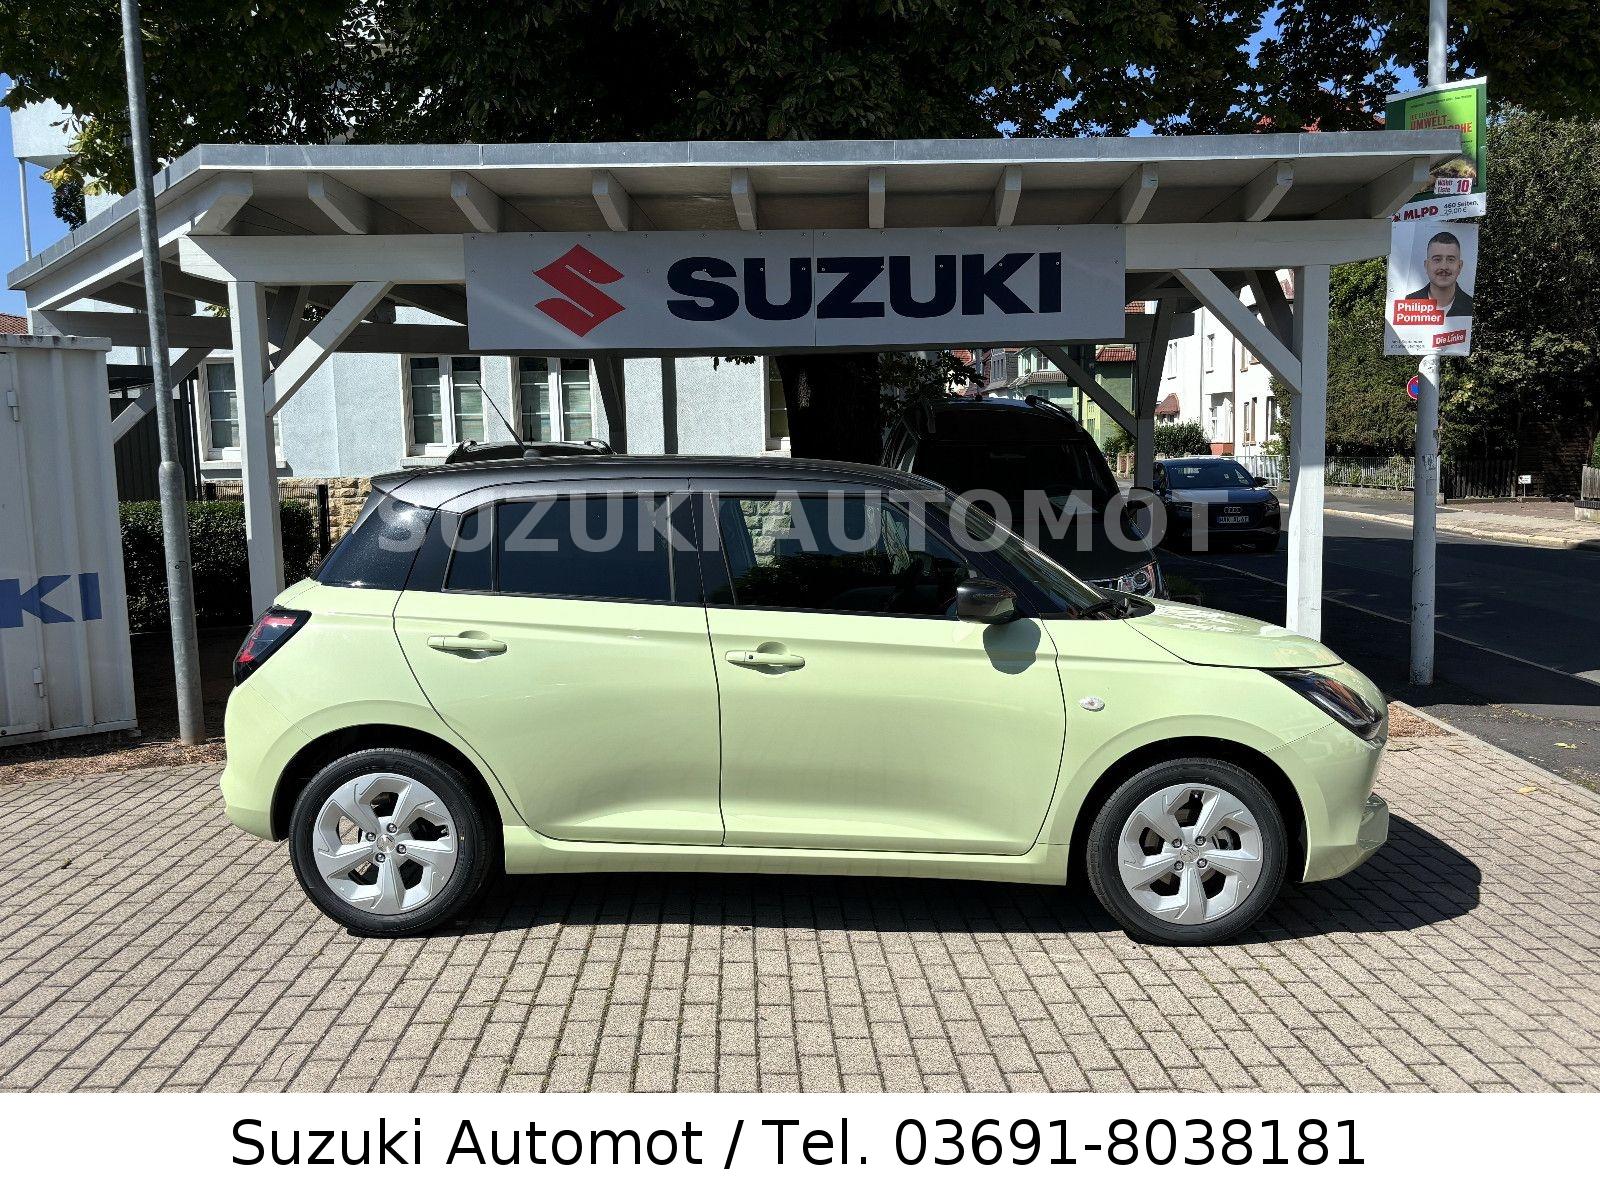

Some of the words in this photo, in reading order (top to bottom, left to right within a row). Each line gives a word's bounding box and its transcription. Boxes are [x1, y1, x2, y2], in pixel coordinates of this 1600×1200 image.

[1456, 179, 1470, 193] 10
[1403, 205, 1439, 220] MLPD
[666, 252, 1062, 321] SUZUKI
[1397, 302, 1434, 313] Philipp
[1396, 313, 1442, 323] Pommer
[1436, 336, 1447, 345] Die
[1447, 334, 1464, 343] Linke
